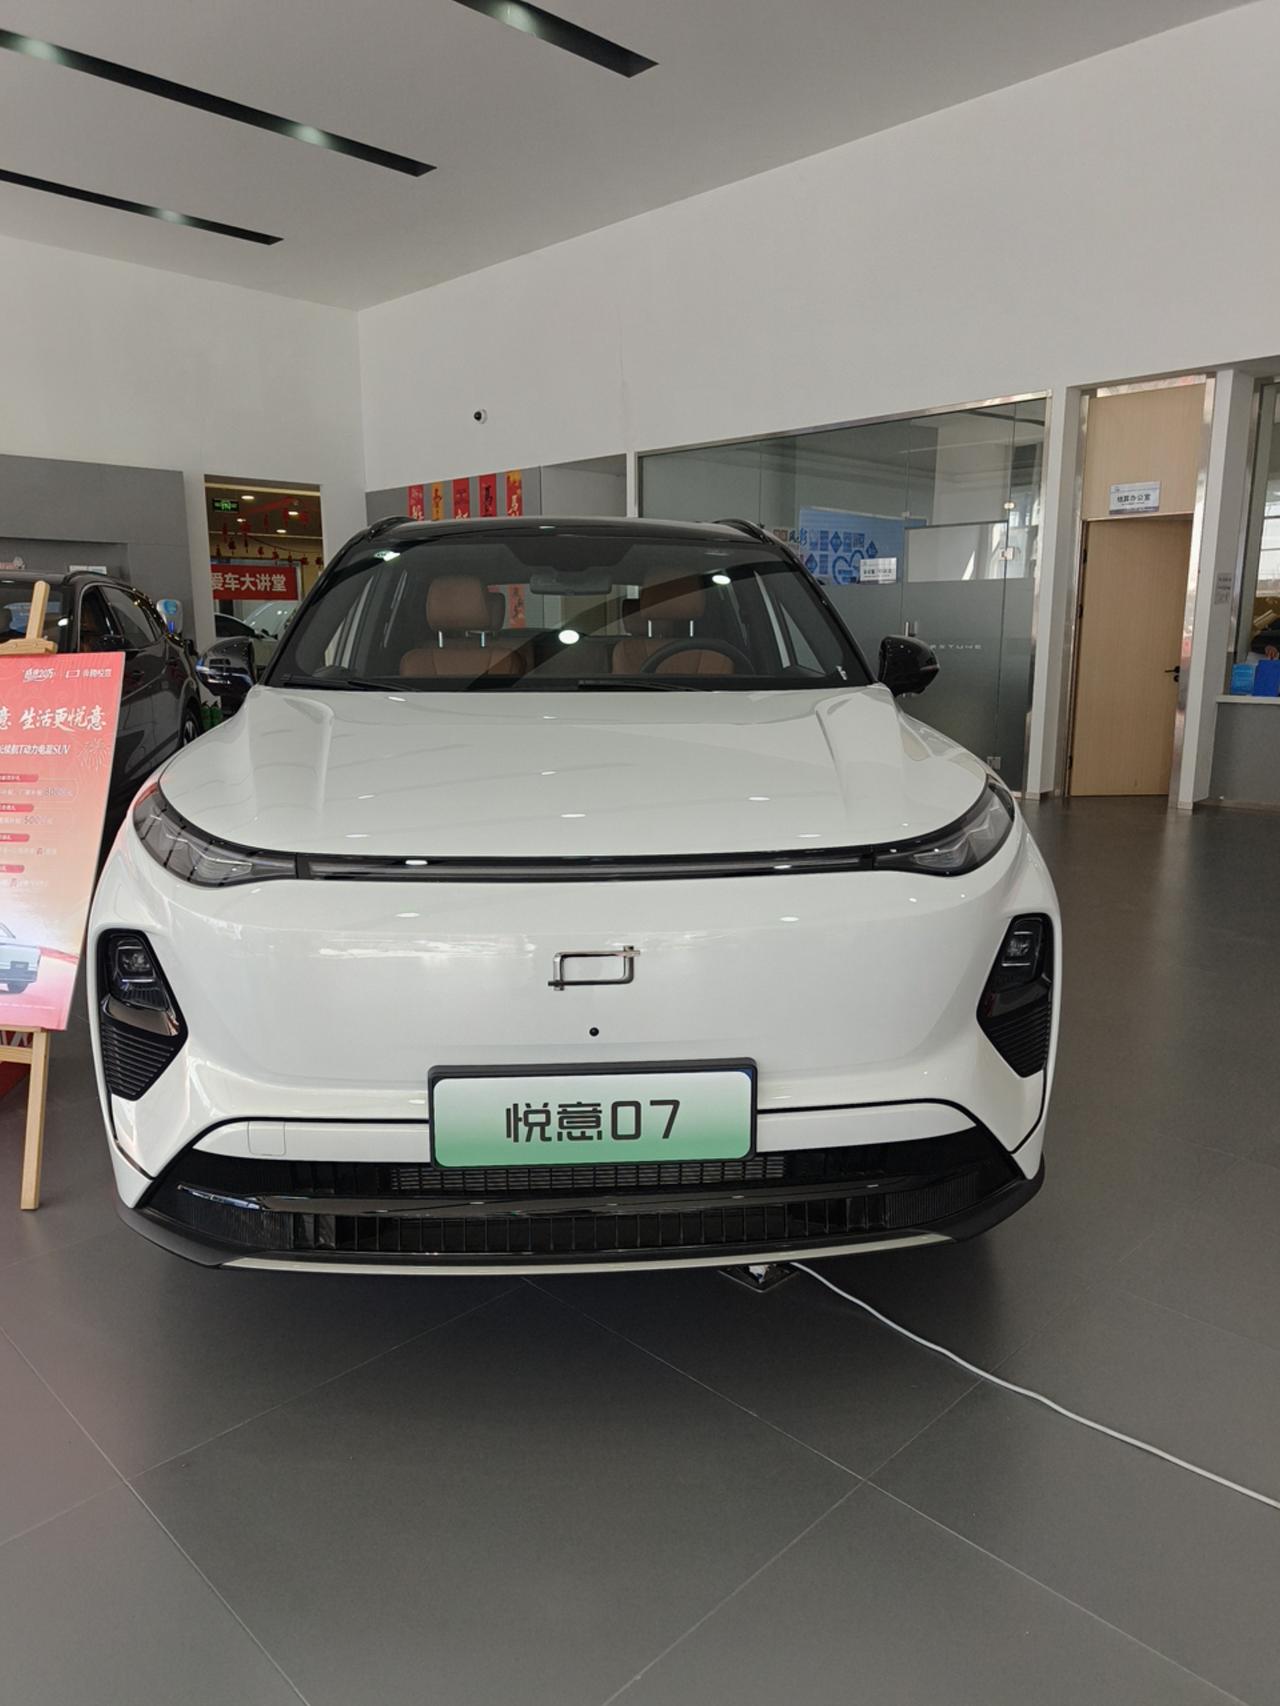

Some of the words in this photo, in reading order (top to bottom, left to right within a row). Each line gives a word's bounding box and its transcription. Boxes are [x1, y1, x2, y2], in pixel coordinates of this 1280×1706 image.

[19, 704, 107, 732] 生活更悦意
[505, 1099, 681, 1143] 悦意07
